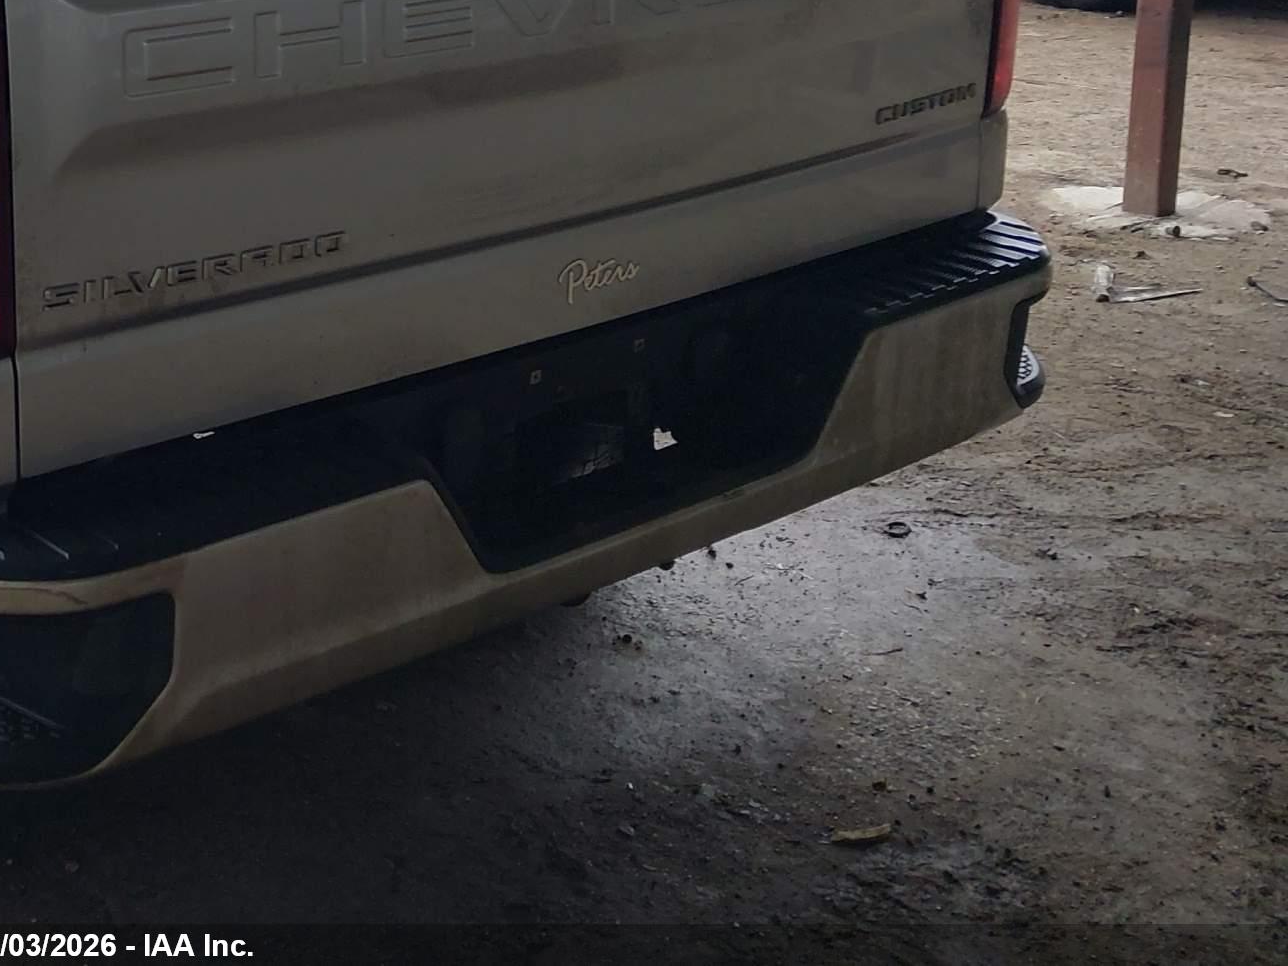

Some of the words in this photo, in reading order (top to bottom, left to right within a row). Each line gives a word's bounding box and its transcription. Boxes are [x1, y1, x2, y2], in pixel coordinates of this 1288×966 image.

[875, 83, 977, 125] CUSTOM
[42, 230, 346, 311] SILVERADO
[558, 258, 640, 305] Peters
